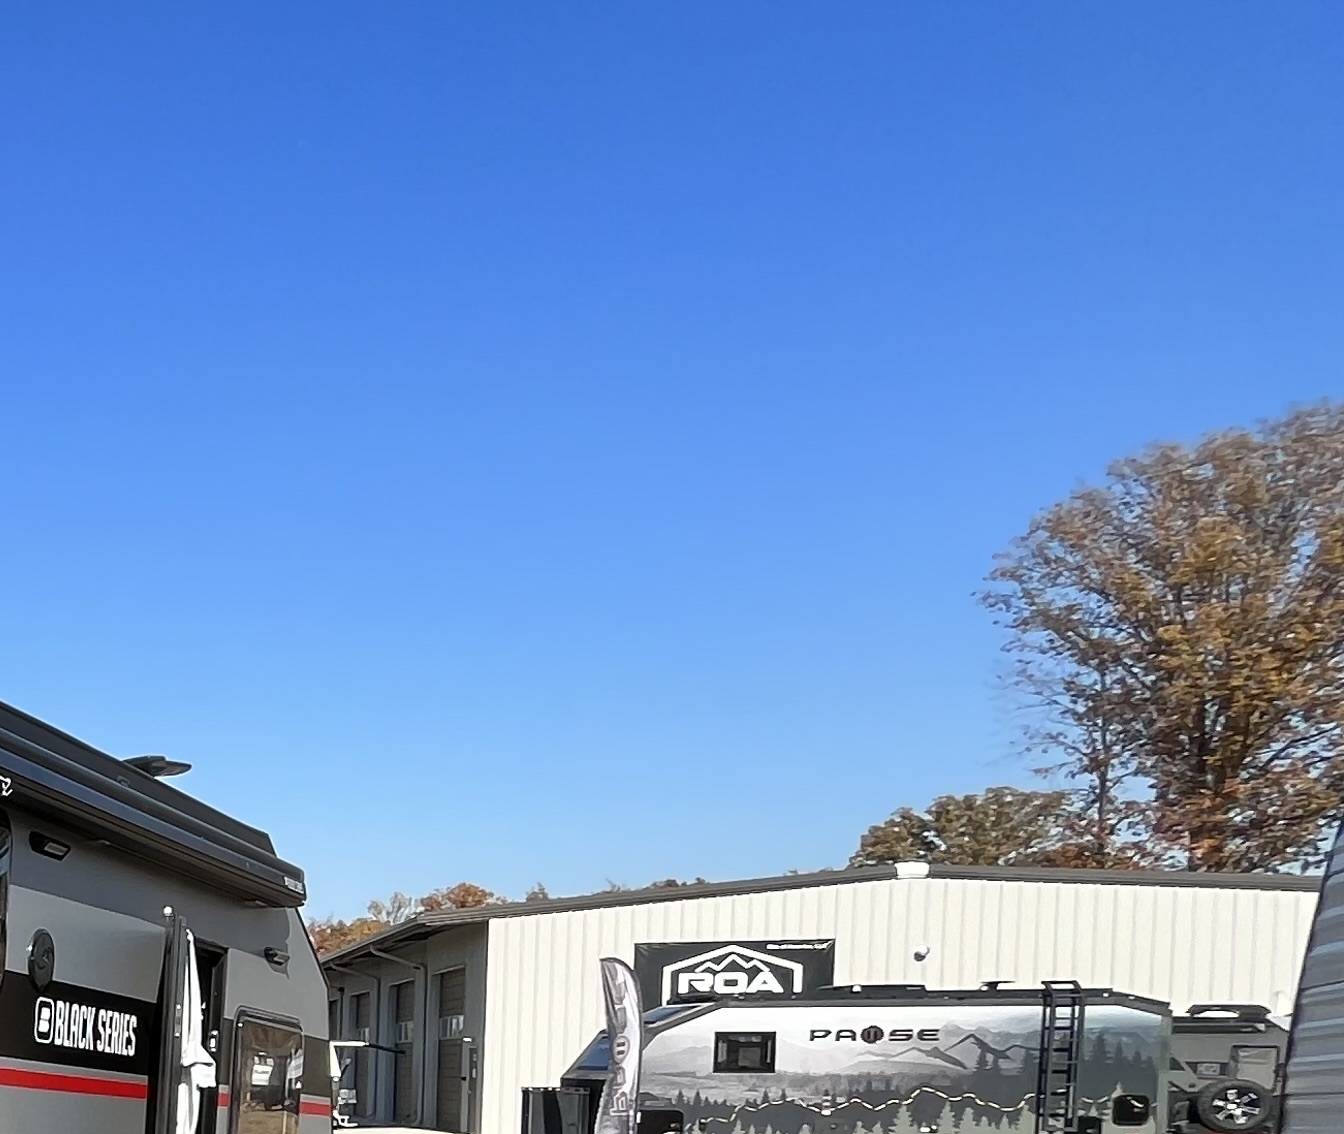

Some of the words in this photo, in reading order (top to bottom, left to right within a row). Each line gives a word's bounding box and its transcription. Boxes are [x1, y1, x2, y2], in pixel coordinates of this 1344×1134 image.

[678, 971, 784, 994] ROA
[54, 1000, 96, 1051] BLACK
[96, 1008, 138, 1057] SERIES
